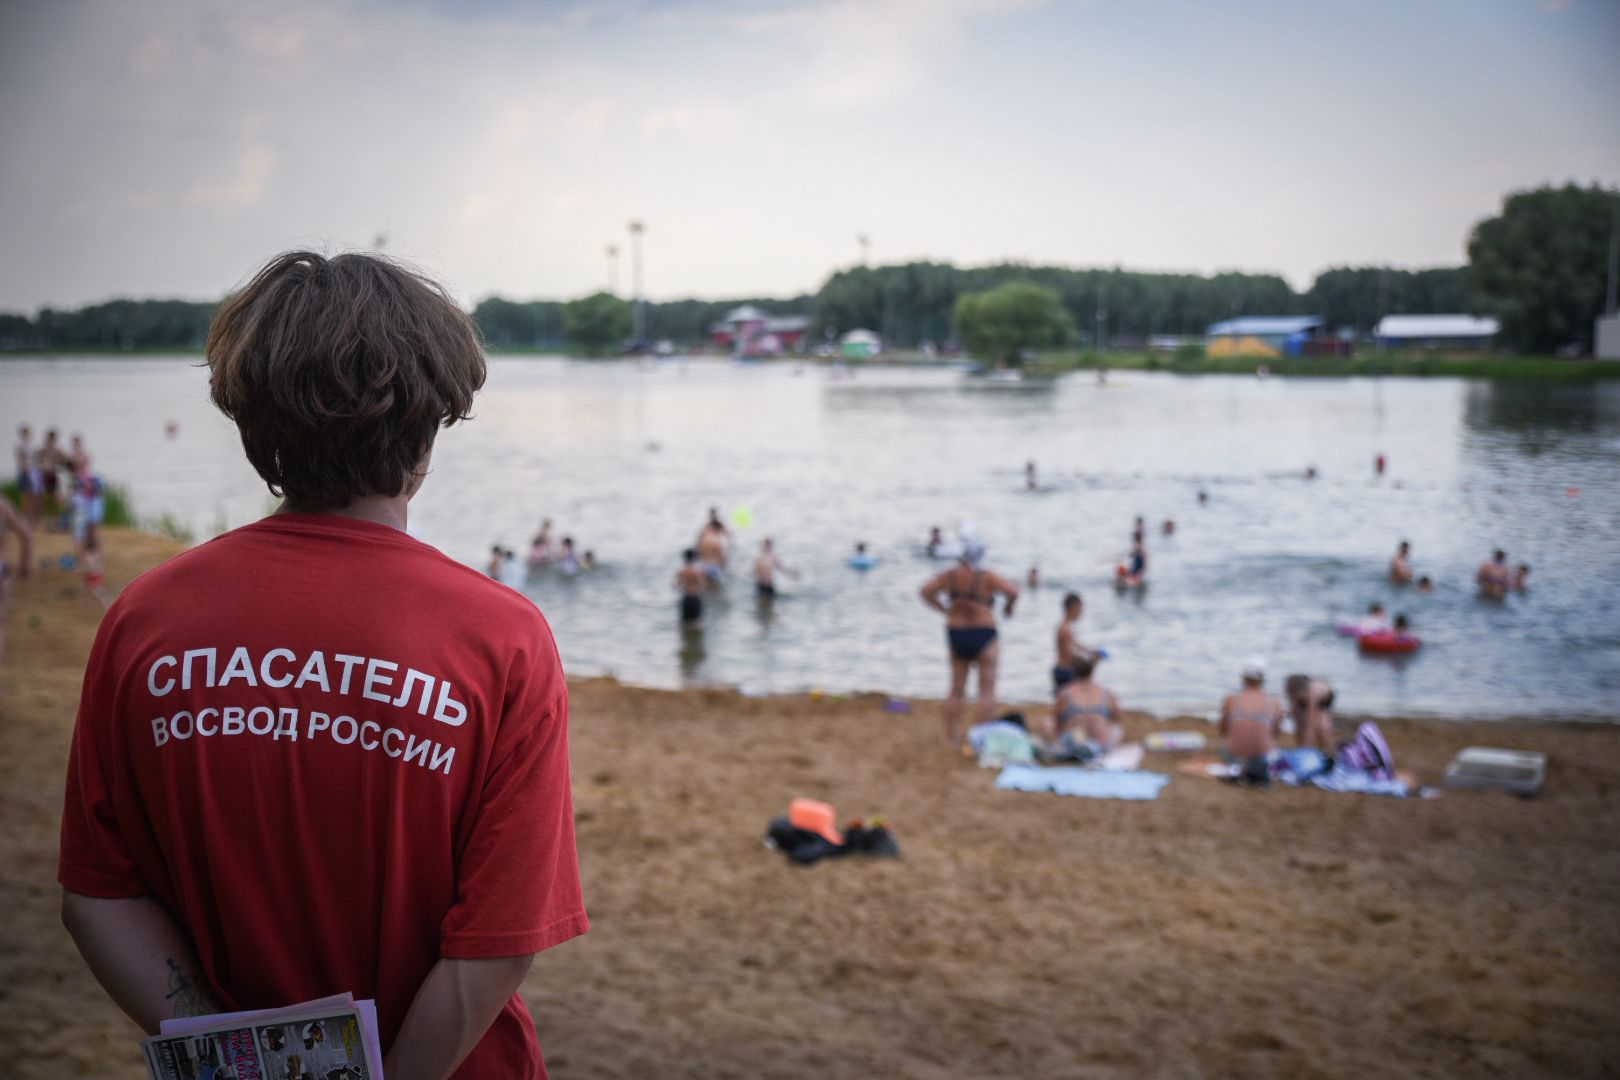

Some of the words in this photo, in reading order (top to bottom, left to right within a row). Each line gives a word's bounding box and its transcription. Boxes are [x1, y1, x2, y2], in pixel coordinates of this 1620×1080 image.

[147, 646, 468, 727] СПАСАТЕЛЬ
[151, 706, 299, 747] ВОСВОД
[307, 711, 456, 775] РОССИИ
